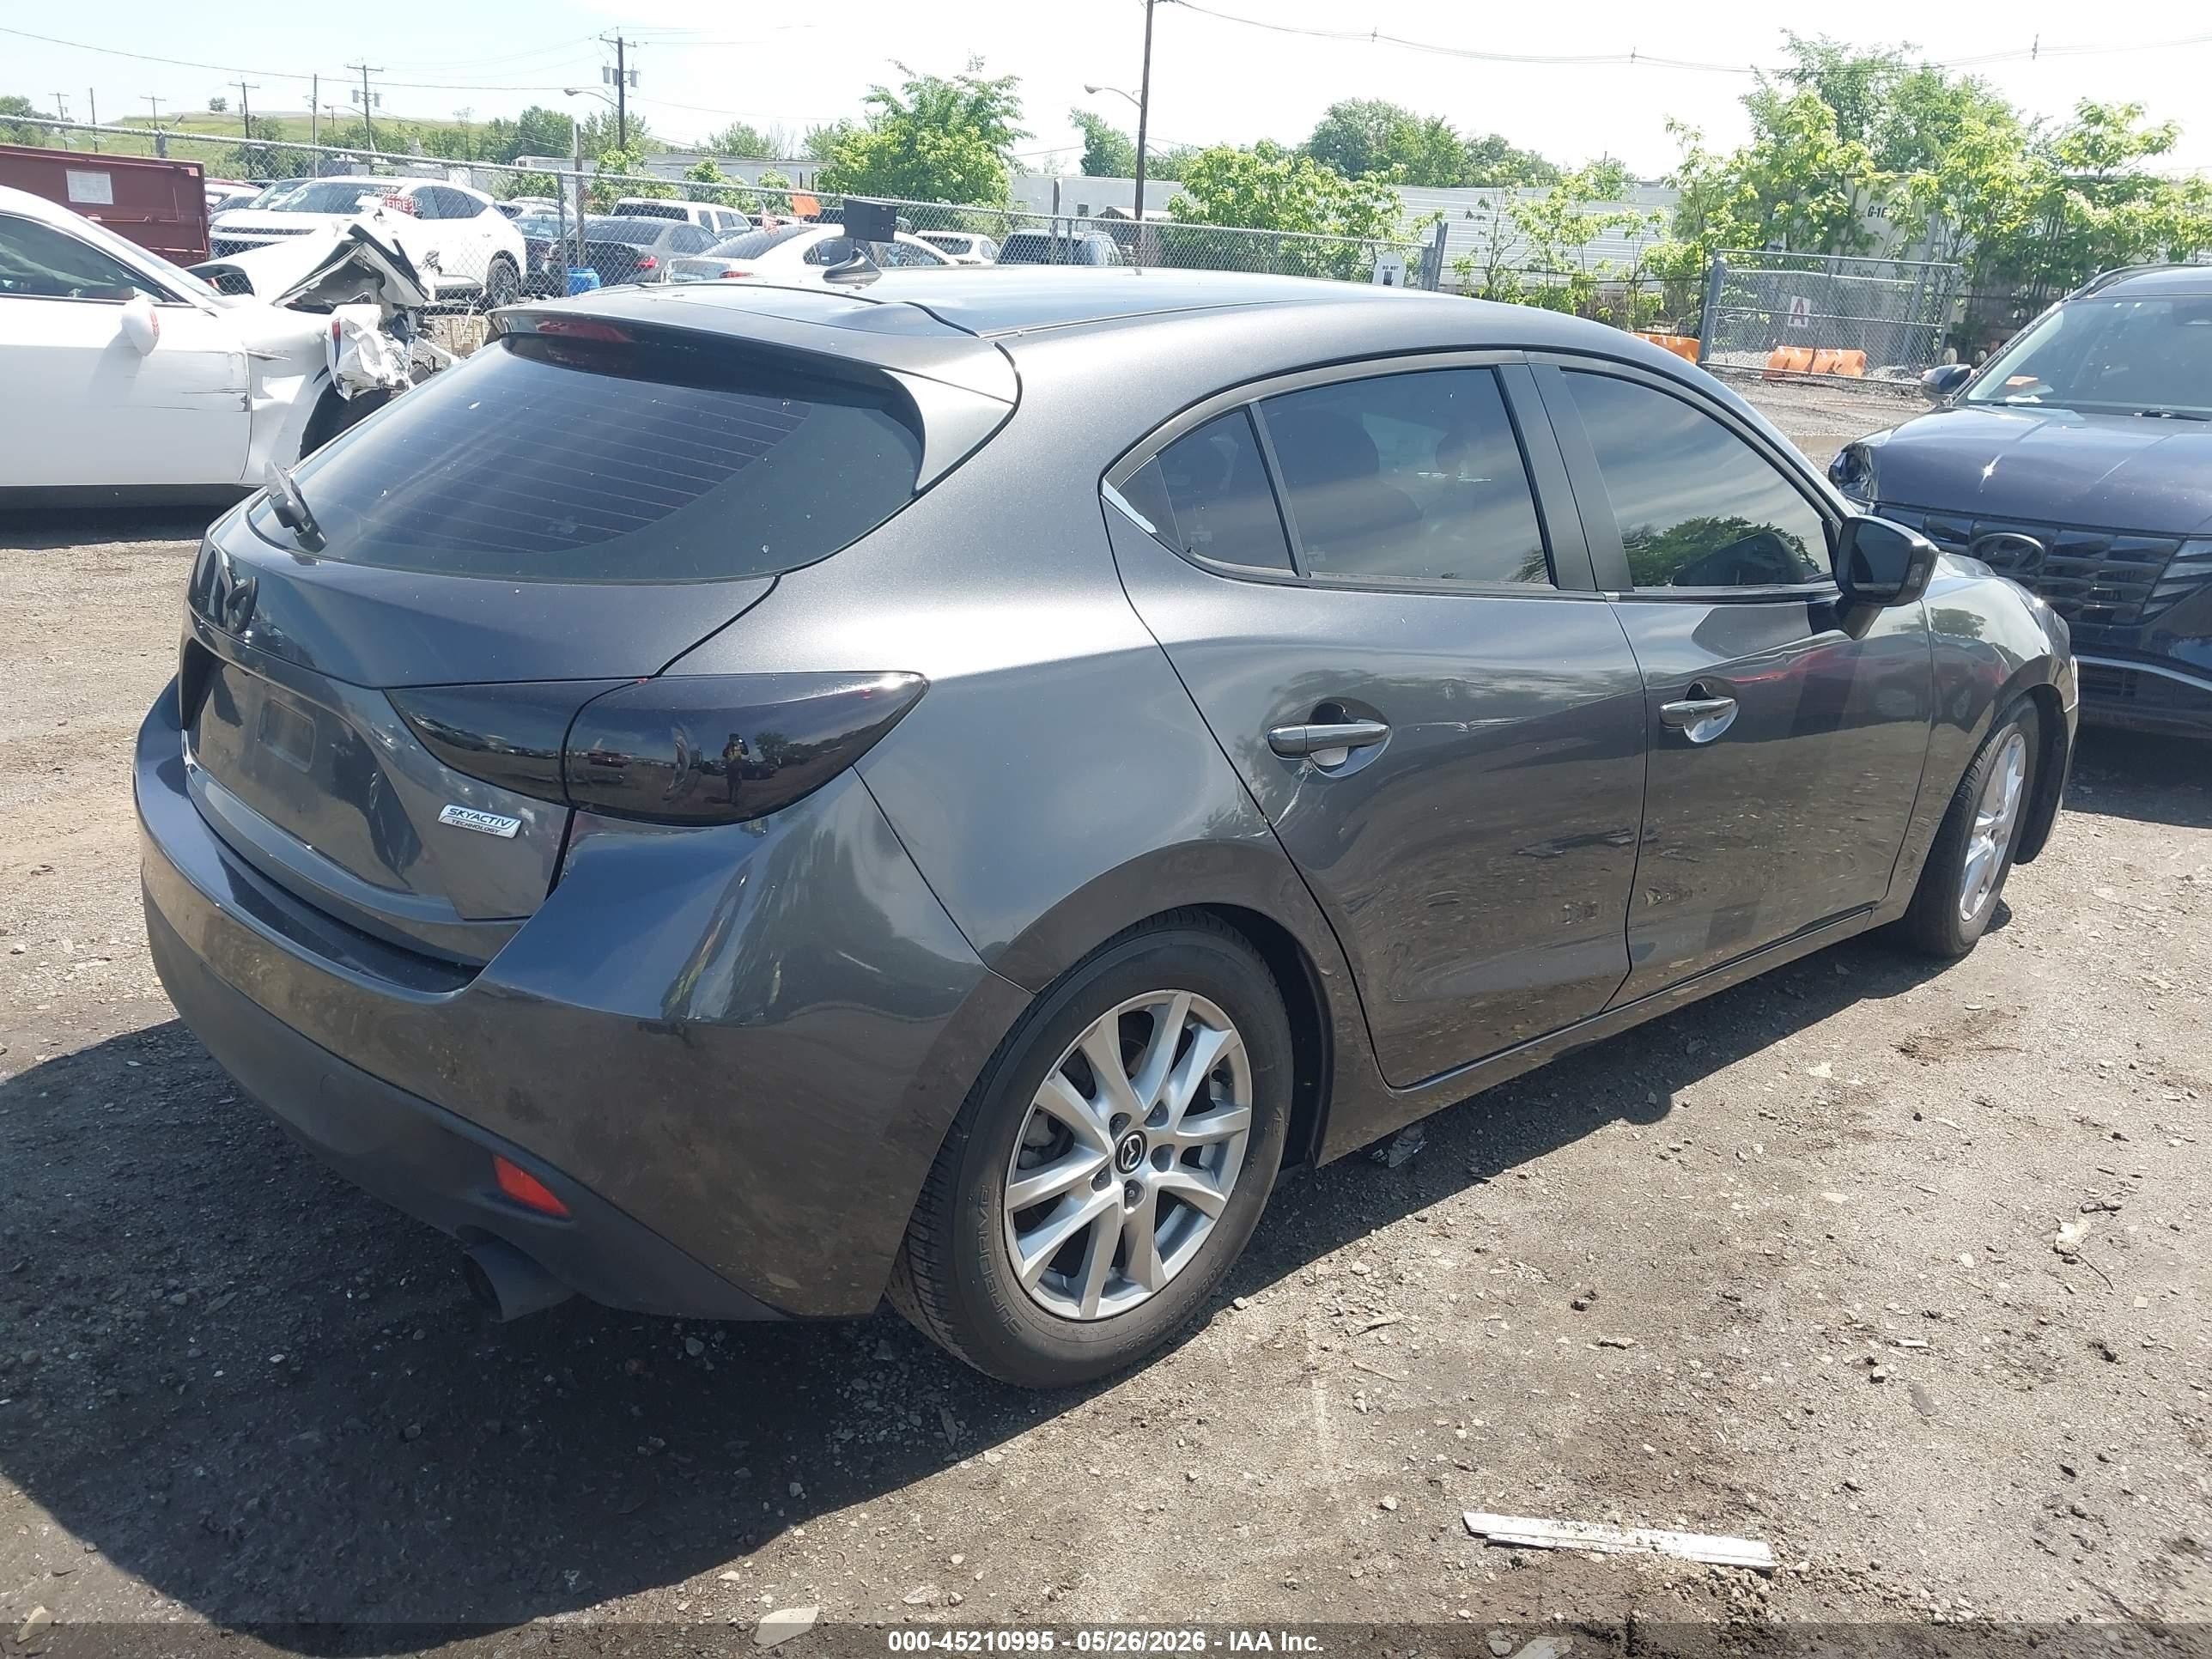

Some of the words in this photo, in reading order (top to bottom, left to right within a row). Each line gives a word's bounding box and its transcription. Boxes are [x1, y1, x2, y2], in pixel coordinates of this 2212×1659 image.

[386, 199, 408, 211] FIRE
[1790, 297, 1806, 325] A
[447, 808, 512, 827] SKYACTIV
[452, 819, 501, 834] TECHNOLOGY
